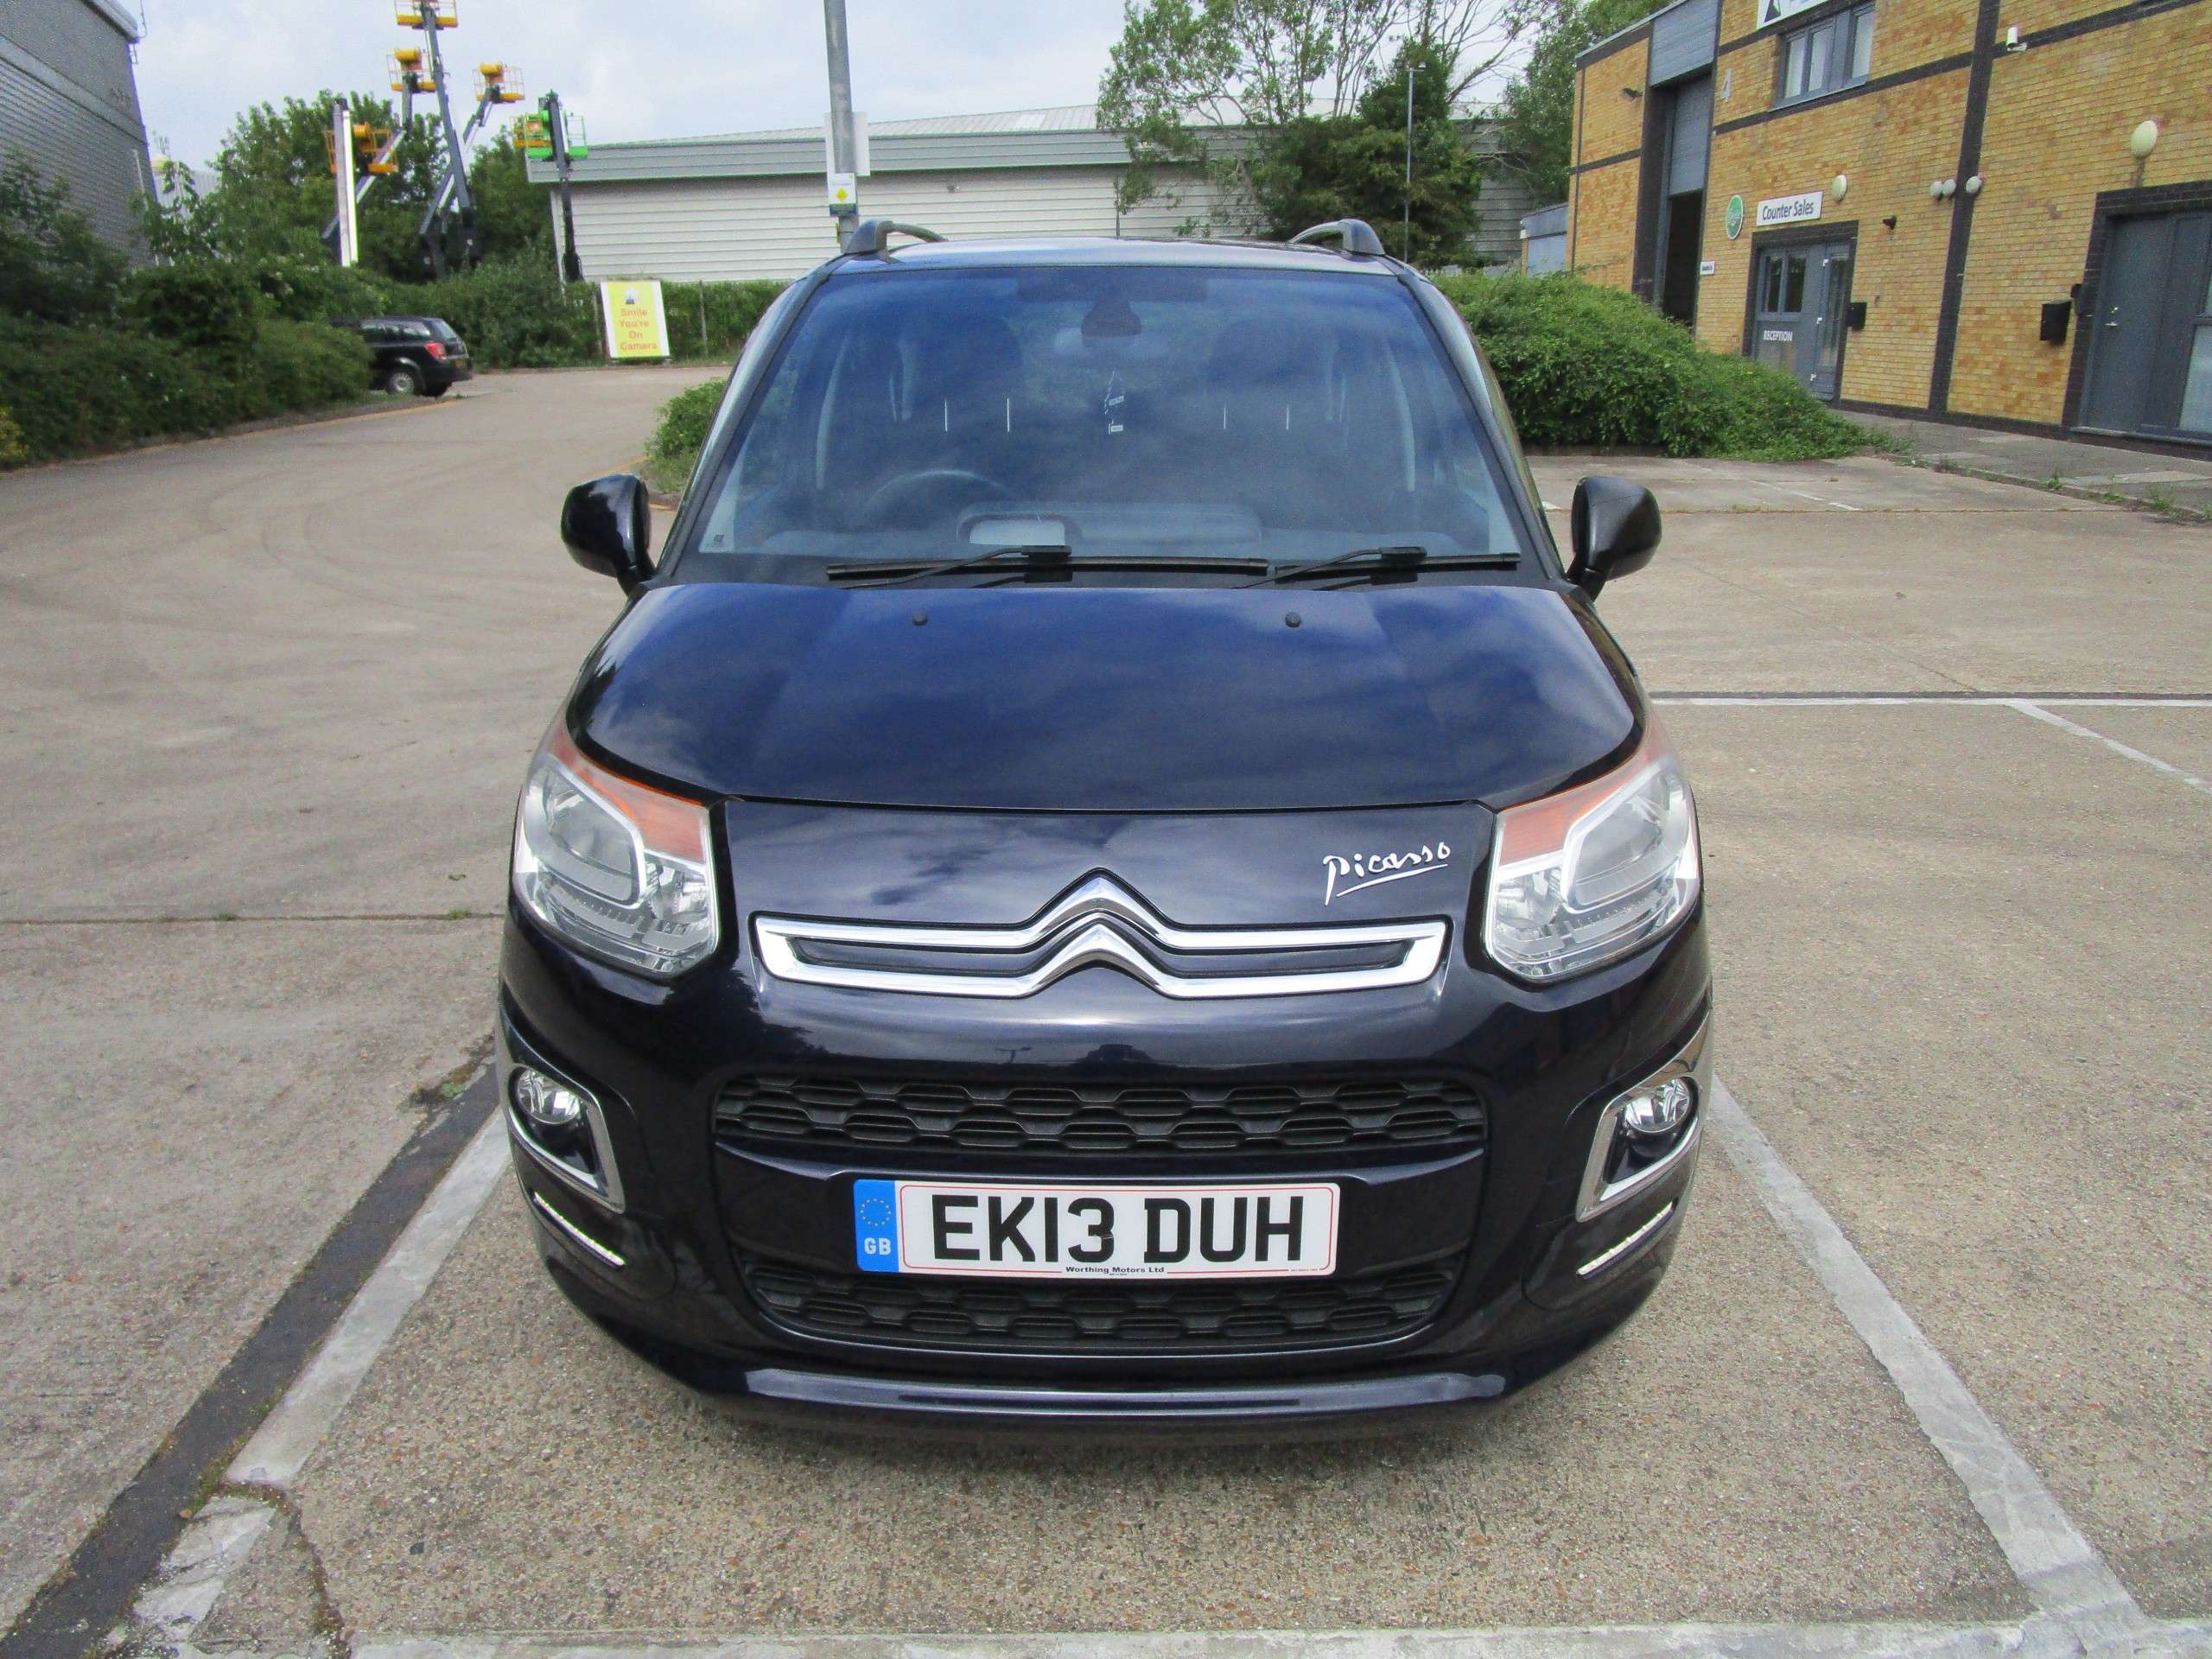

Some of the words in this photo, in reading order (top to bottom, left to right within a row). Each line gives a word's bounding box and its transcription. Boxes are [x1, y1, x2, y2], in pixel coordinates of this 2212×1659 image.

[1763, 203, 1793, 220] Counter
[1794, 199, 1815, 217] Sales
[629, 330, 644, 339] On
[1763, 330, 1794, 341] RECEPTION
[931, 1194, 1116, 1263] EK13
[1143, 1196, 1305, 1263] DUH
[864, 1237, 892, 1255] GB
